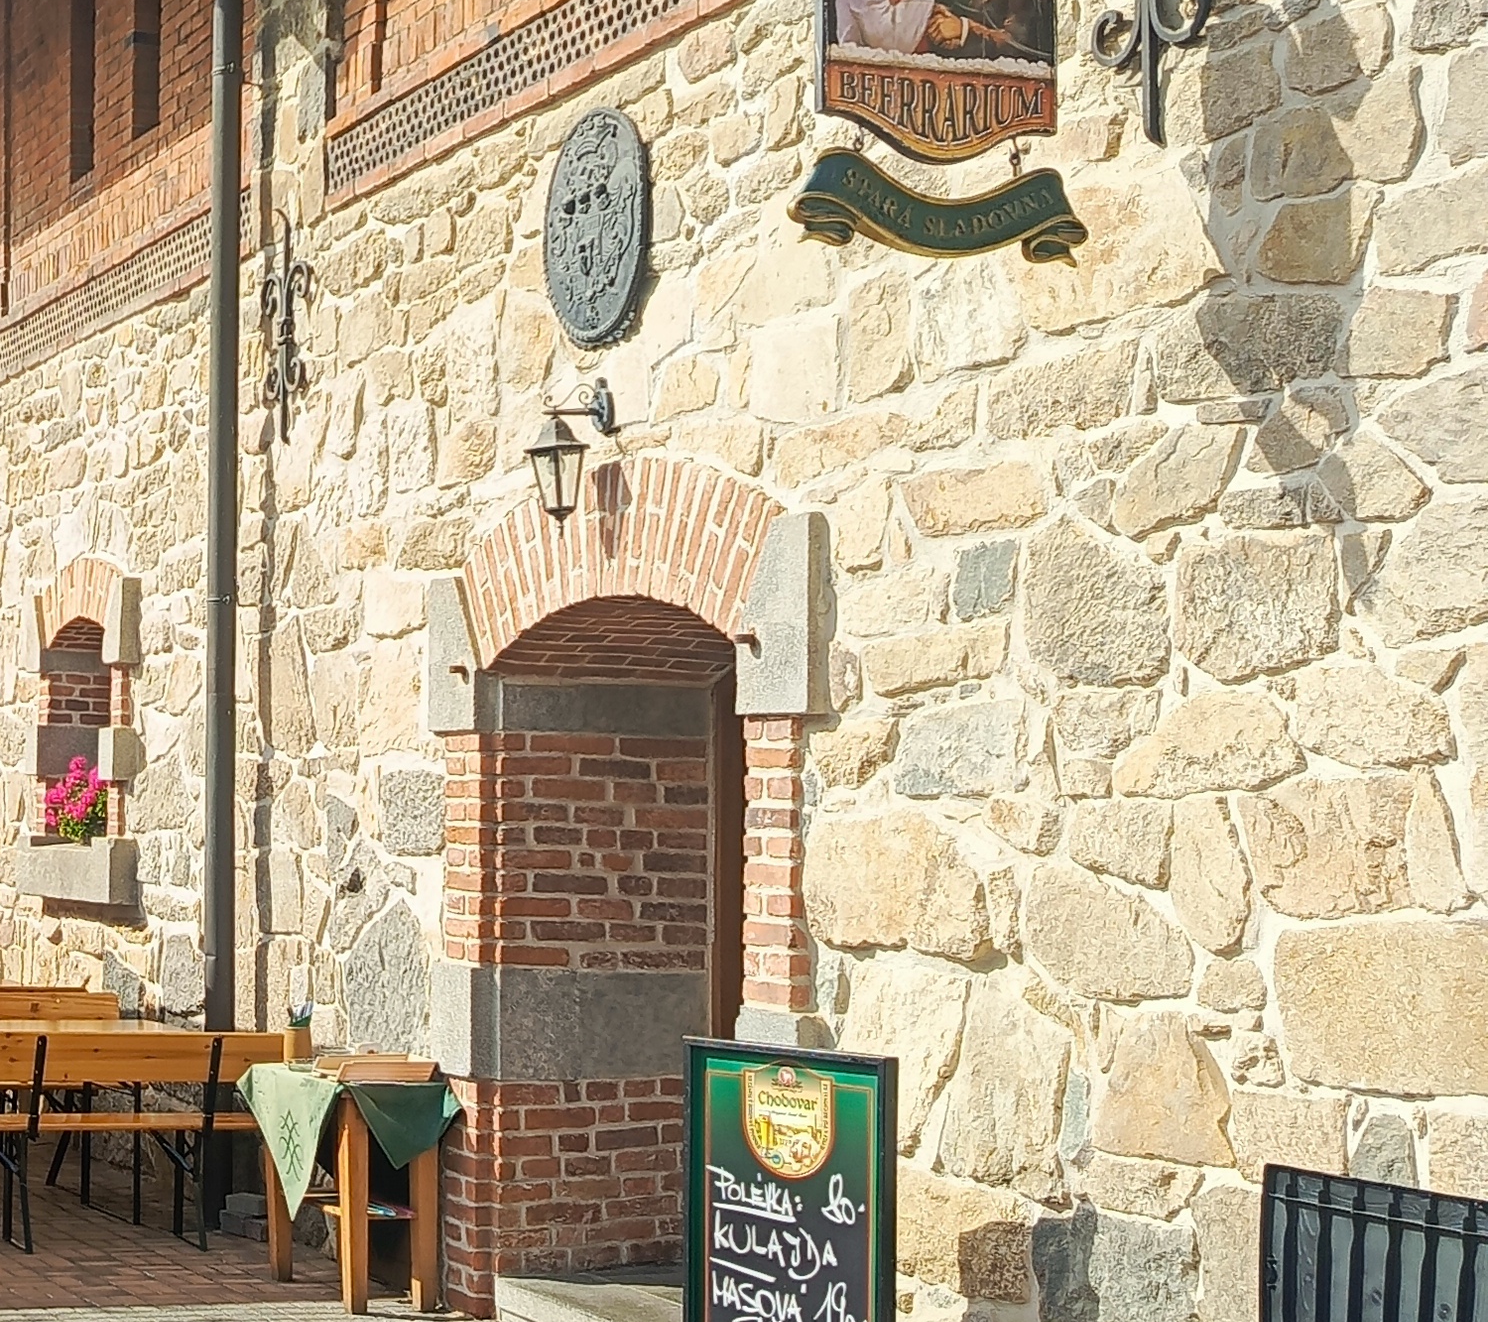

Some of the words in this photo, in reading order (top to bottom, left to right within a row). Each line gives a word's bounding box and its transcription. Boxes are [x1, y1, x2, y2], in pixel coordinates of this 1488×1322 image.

[838, 70, 1046, 146] BEERRARIUM
[923, 188, 1054, 237] SLADOVNA
[757, 1090, 818, 1111] Chodovar
[713, 1209, 838, 1280] KULAJDA
